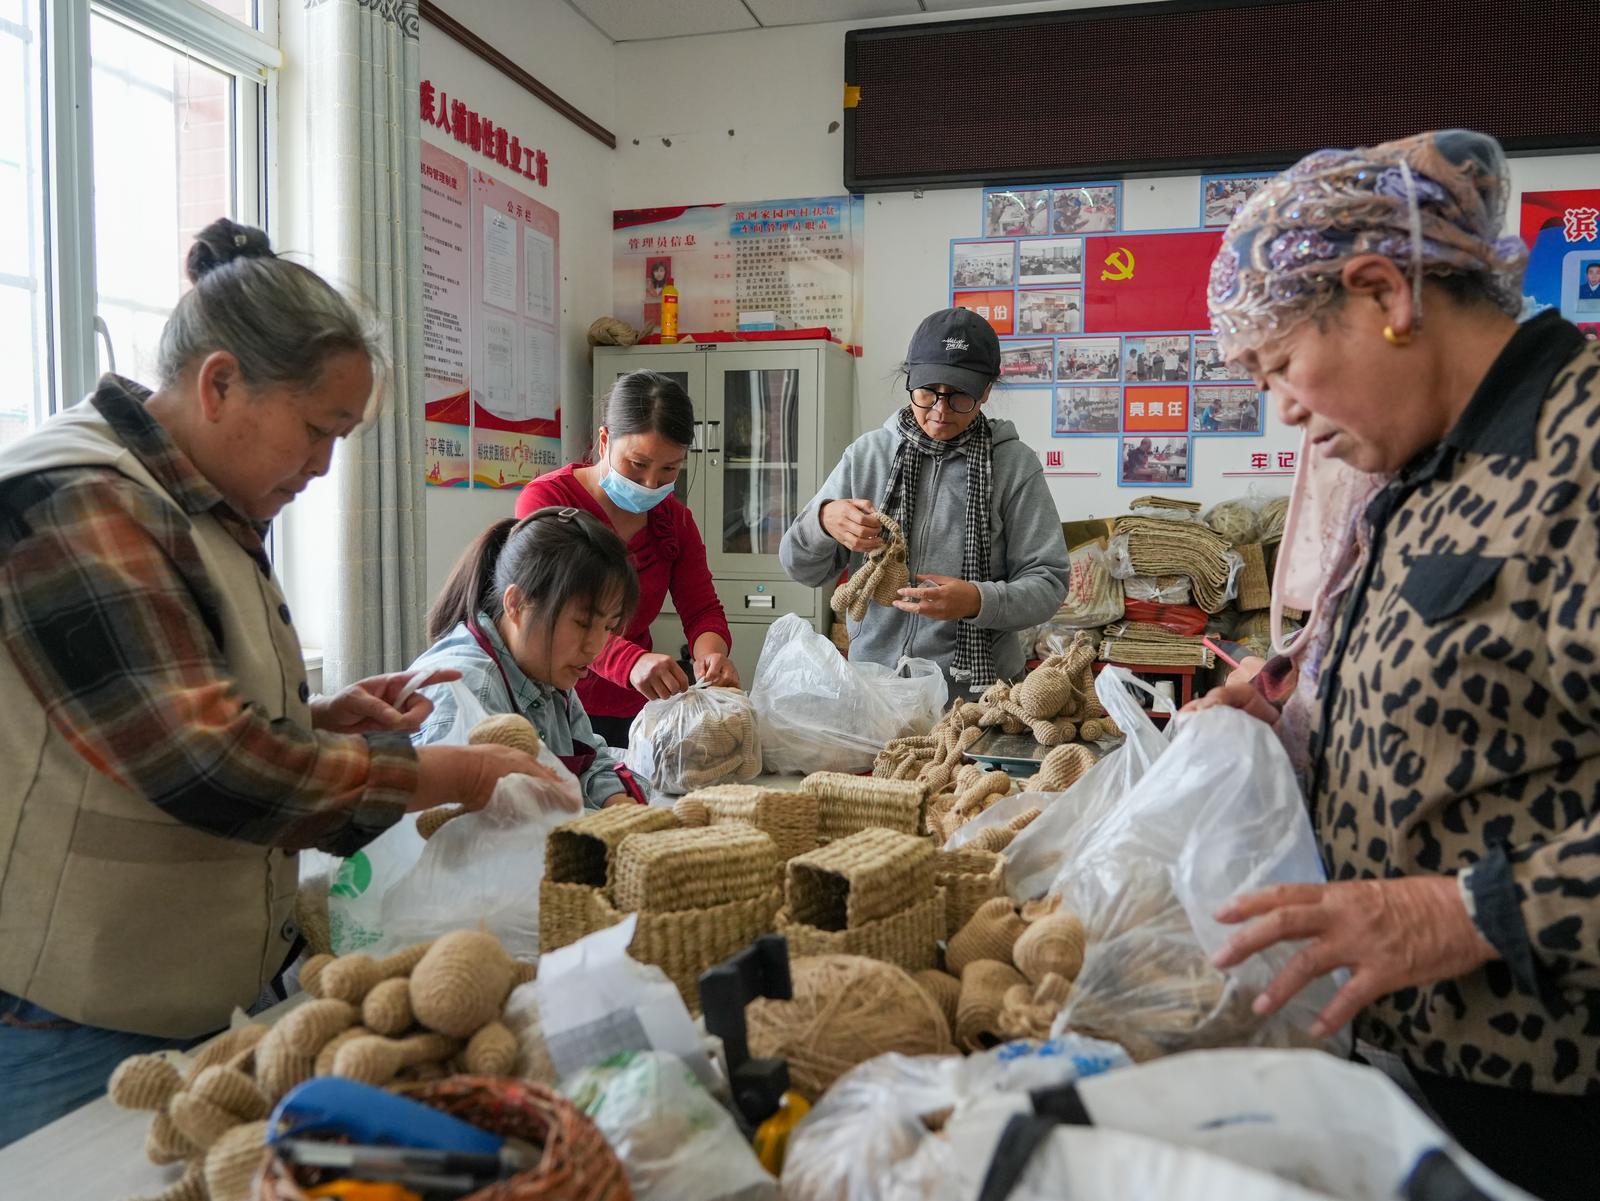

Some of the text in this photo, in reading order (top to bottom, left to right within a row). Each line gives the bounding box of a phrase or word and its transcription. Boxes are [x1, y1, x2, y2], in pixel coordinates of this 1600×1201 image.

[507, 200, 533, 223] 公示栏
[1563, 207, 1599, 243] 滨
[628, 234, 697, 249] 管理员信息
[964, 305, 1008, 321] 身份
[1129, 401, 1182, 417] 亮责任
[1251, 452, 1295, 469] 牢记
